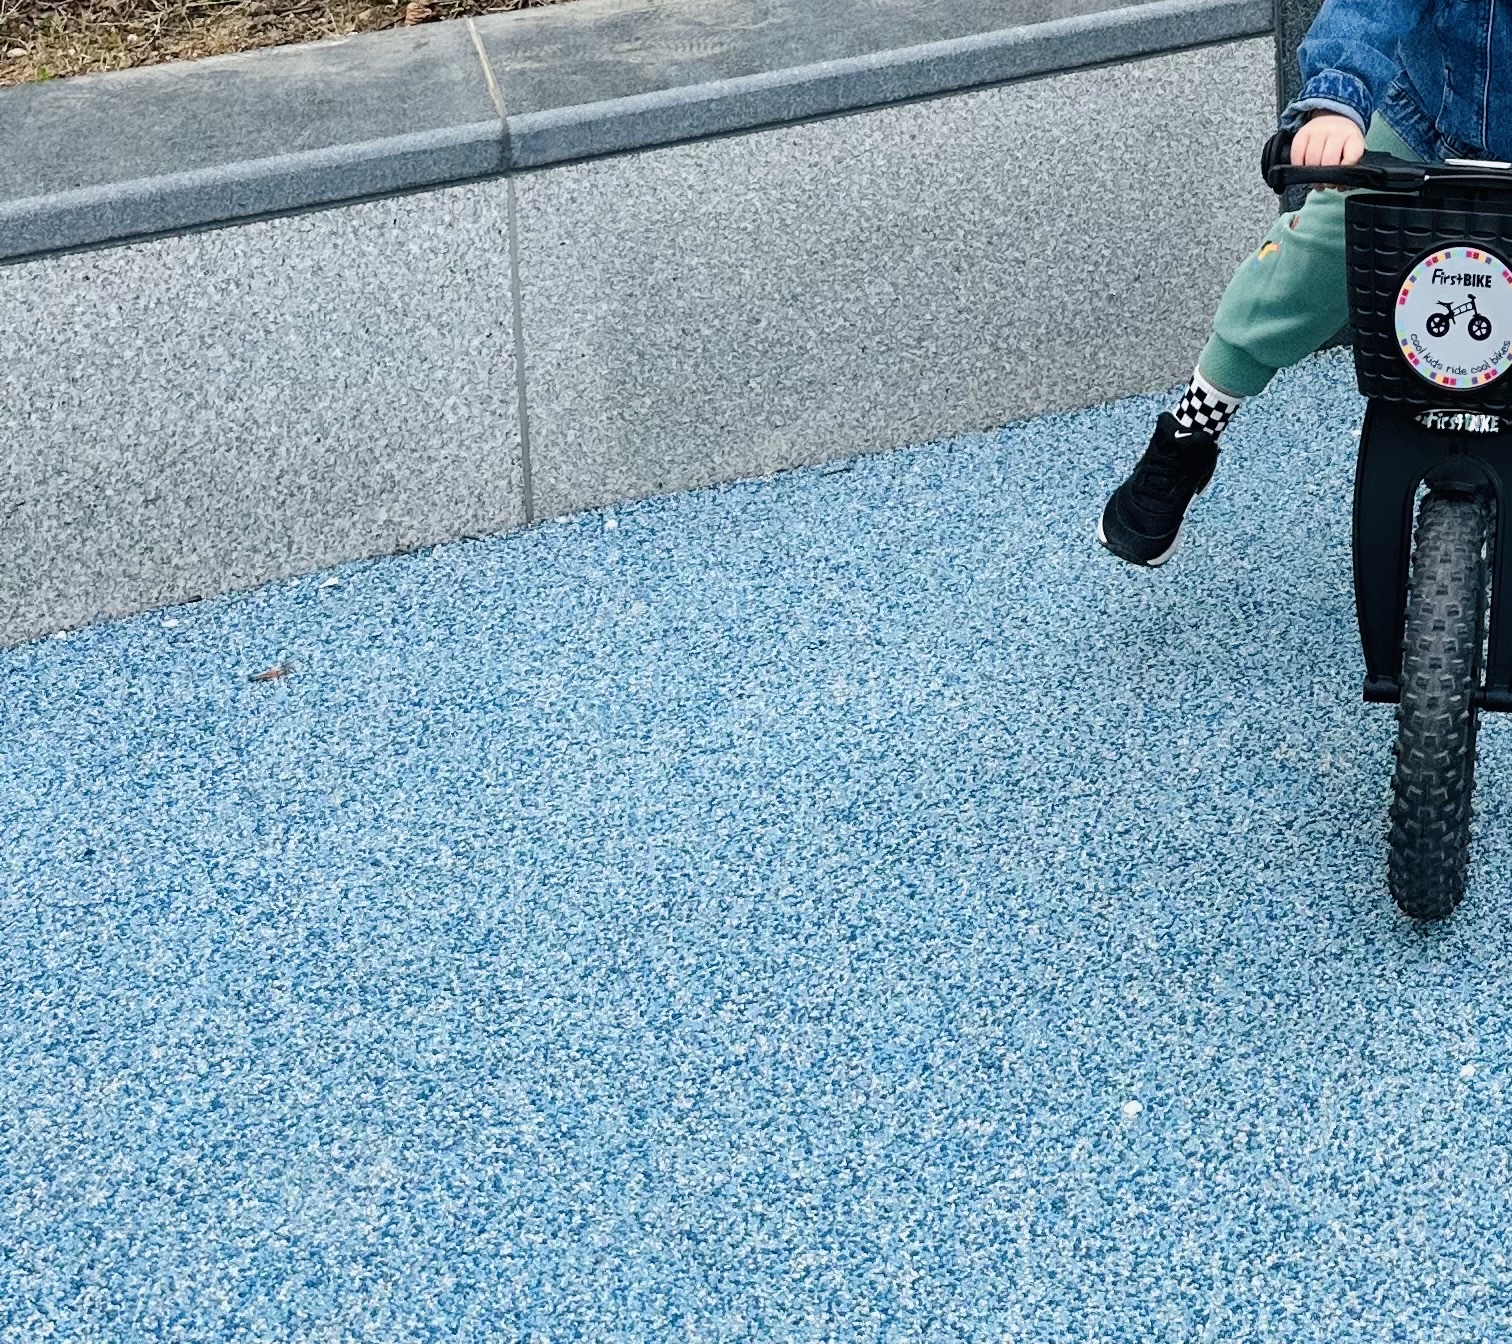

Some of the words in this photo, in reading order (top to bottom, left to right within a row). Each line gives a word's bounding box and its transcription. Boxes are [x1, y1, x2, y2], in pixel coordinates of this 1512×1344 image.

[1431, 268, 1492, 289] FirstBIKE
[1410, 333, 1428, 354] cool
[1422, 351, 1443, 370] kids
[1445, 365, 1468, 375] ride
[1470, 359, 1491, 374] cool
[1488, 340, 1510, 366] bikes
